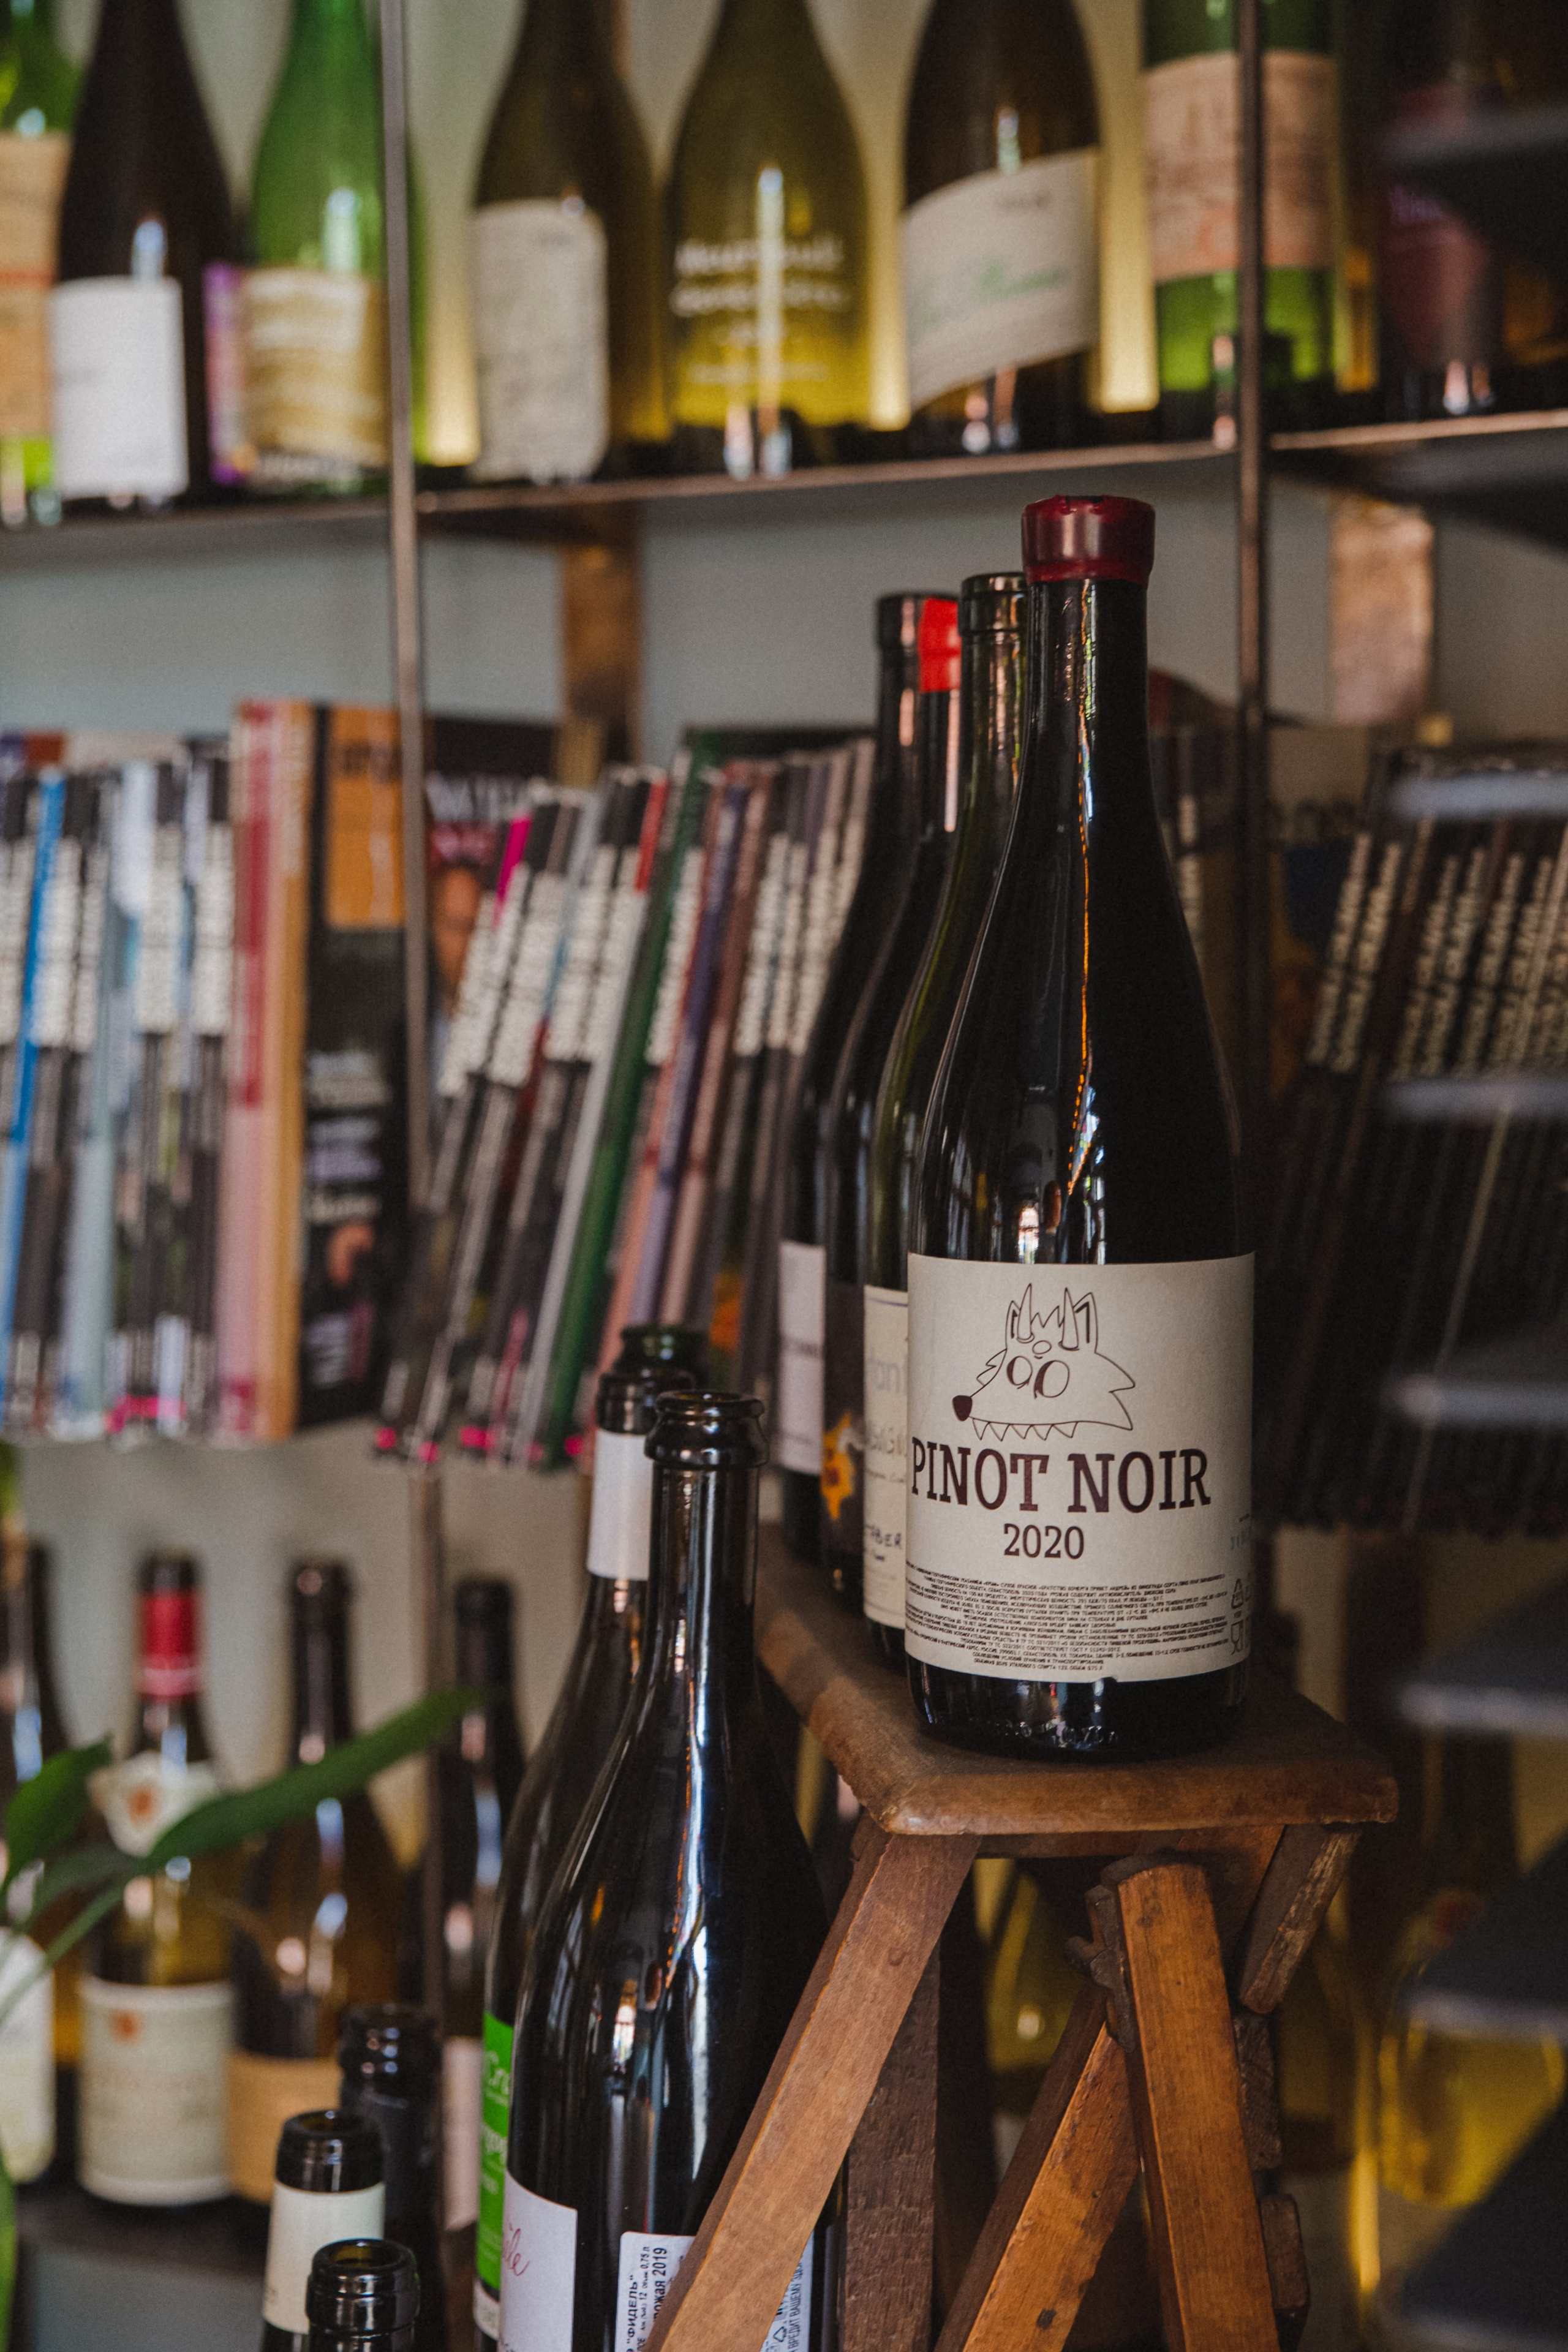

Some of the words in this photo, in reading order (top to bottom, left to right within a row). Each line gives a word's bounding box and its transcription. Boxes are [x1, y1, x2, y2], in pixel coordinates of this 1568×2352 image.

[912, 1436, 1050, 1511] PINOT
[1067, 1448, 1212, 1513] NOIR
[1003, 1523, 1085, 1559] 2020
[640, 2253, 649, 2269] 0,75
[652, 2247, 668, 2276] 2019
[639, 2292, 647, 2301] 12
[788, 2283, 802, 2317] ВАШЕМУ
[788, 2318, 801, 2348] ВРЕДИТ
